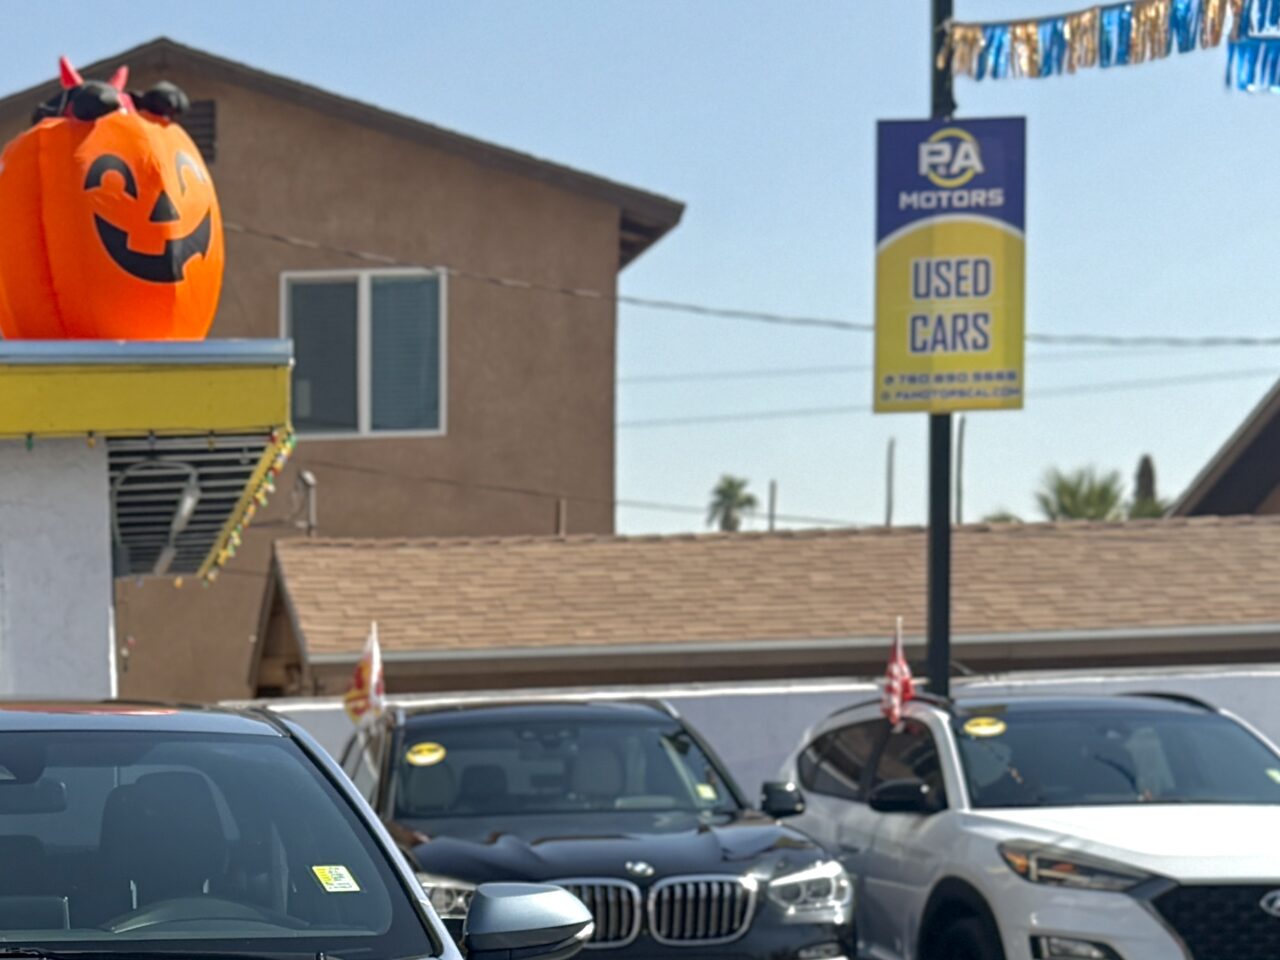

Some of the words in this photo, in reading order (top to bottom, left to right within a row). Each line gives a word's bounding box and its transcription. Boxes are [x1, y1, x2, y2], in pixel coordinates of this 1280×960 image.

[899, 188, 1004, 210] MOTORS
[912, 258, 992, 300] USED
[908, 312, 991, 354] CARS
